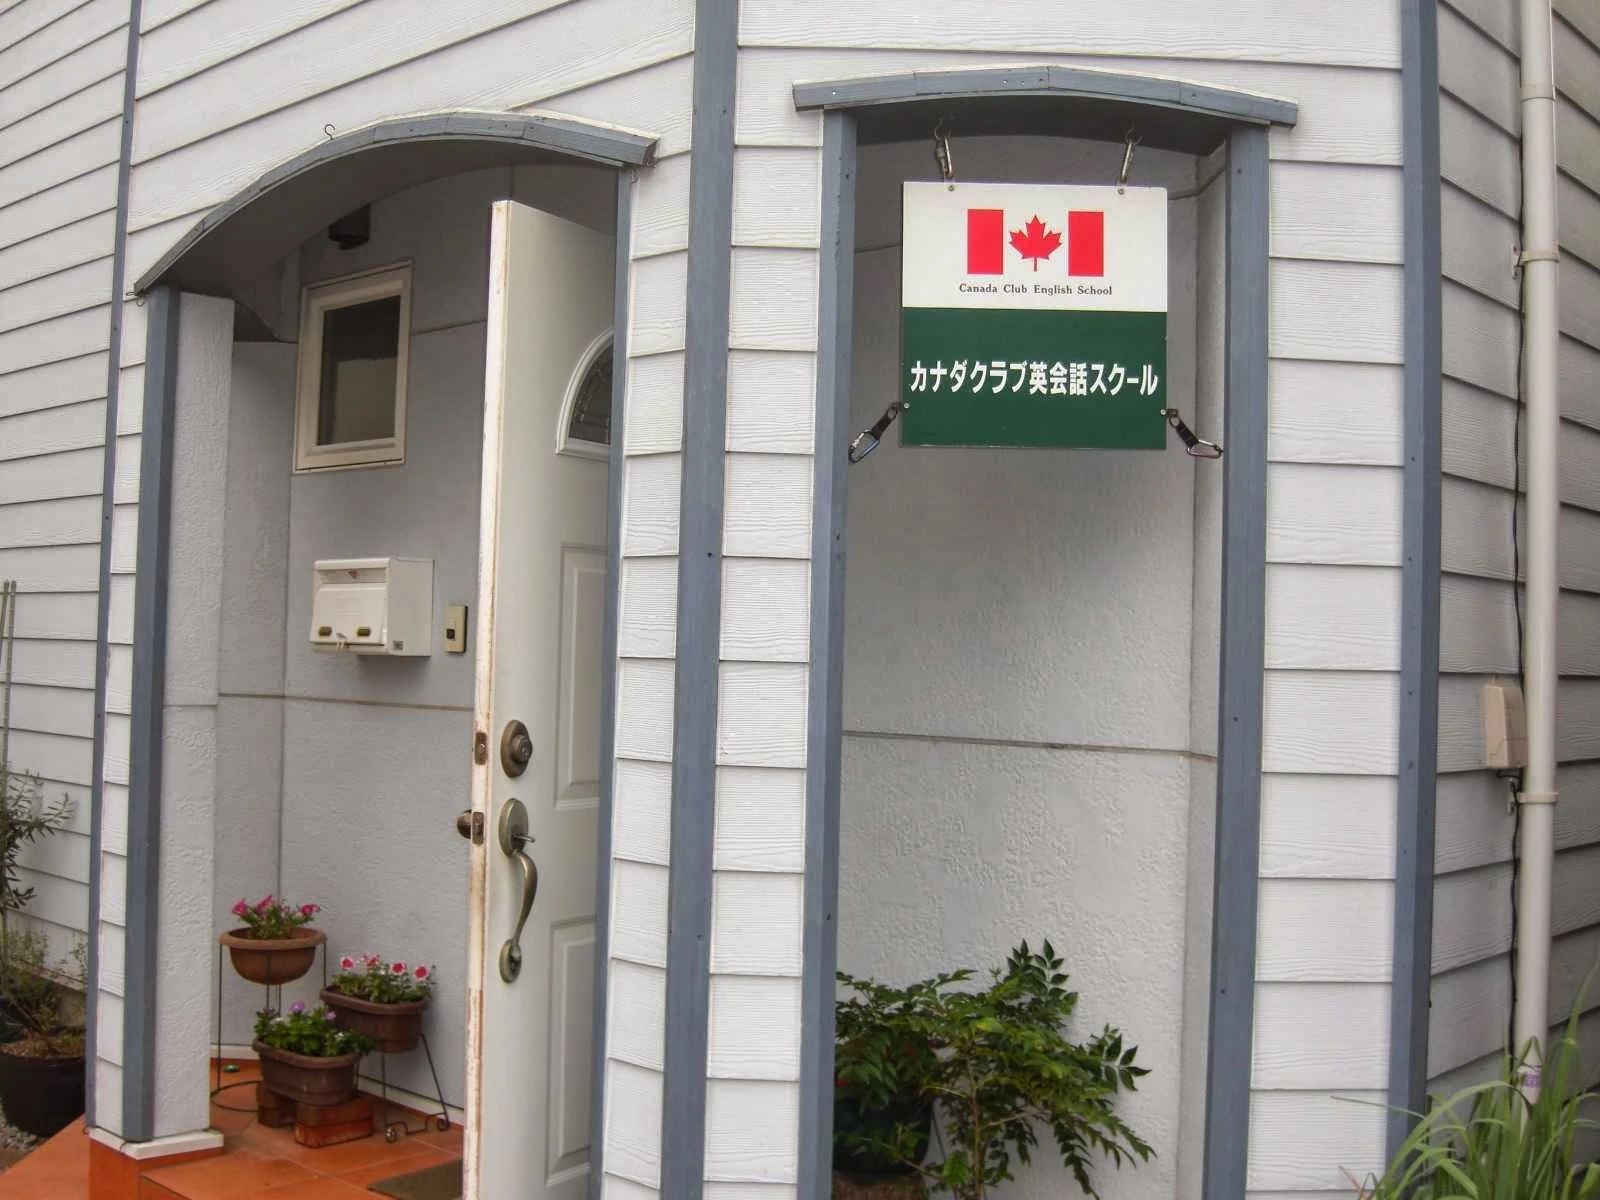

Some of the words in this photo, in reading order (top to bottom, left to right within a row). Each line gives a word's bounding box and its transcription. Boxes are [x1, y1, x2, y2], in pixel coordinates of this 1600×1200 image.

[958, 283, 998, 294] Canada
[1003, 283, 1028, 295] Club
[1033, 284, 1073, 297] English
[1077, 285, 1113, 296] School
[909, 359, 1159, 397] カナダクラブ英会話スクール
